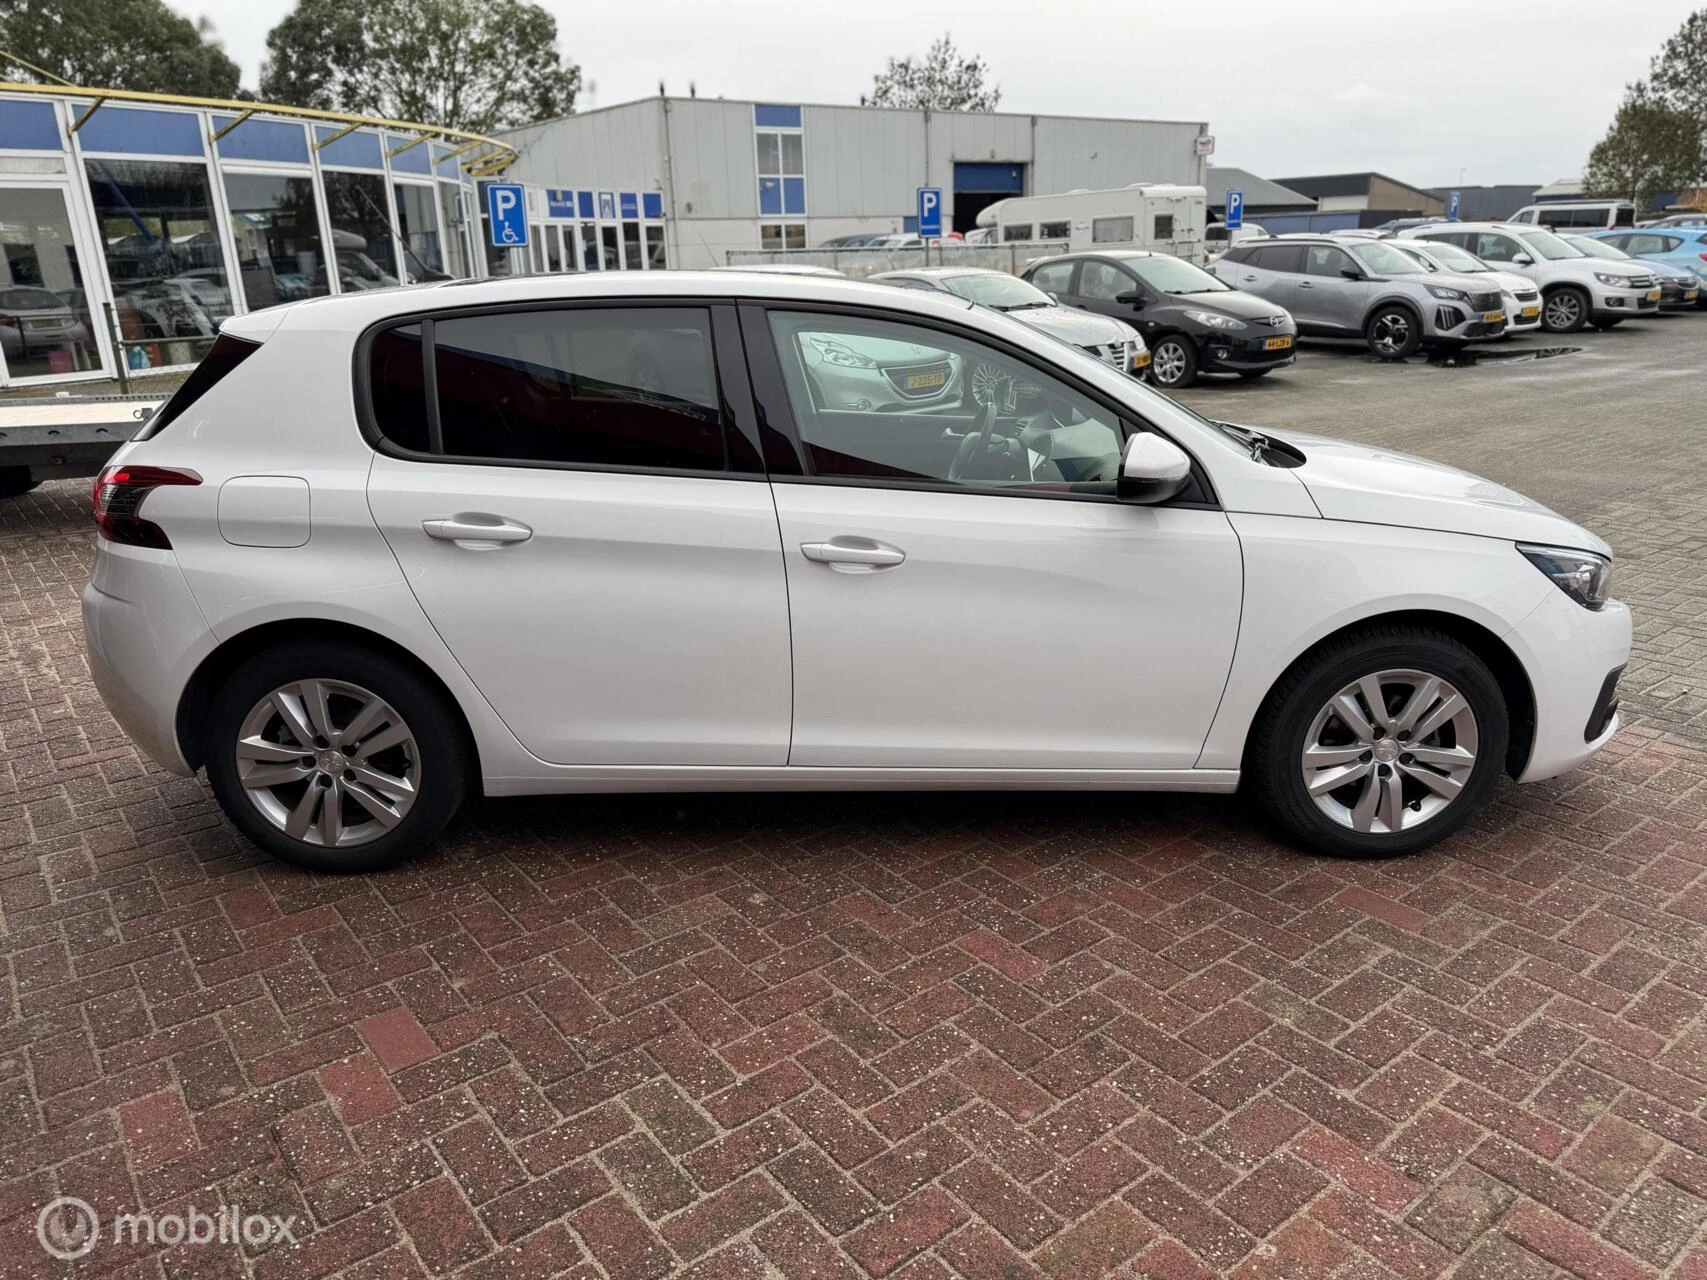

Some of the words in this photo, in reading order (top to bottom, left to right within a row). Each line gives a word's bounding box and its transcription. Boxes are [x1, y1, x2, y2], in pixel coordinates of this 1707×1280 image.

[496, 190, 516, 220] P
[923, 193, 936, 217] P
[1229, 193, 1240, 214] P
